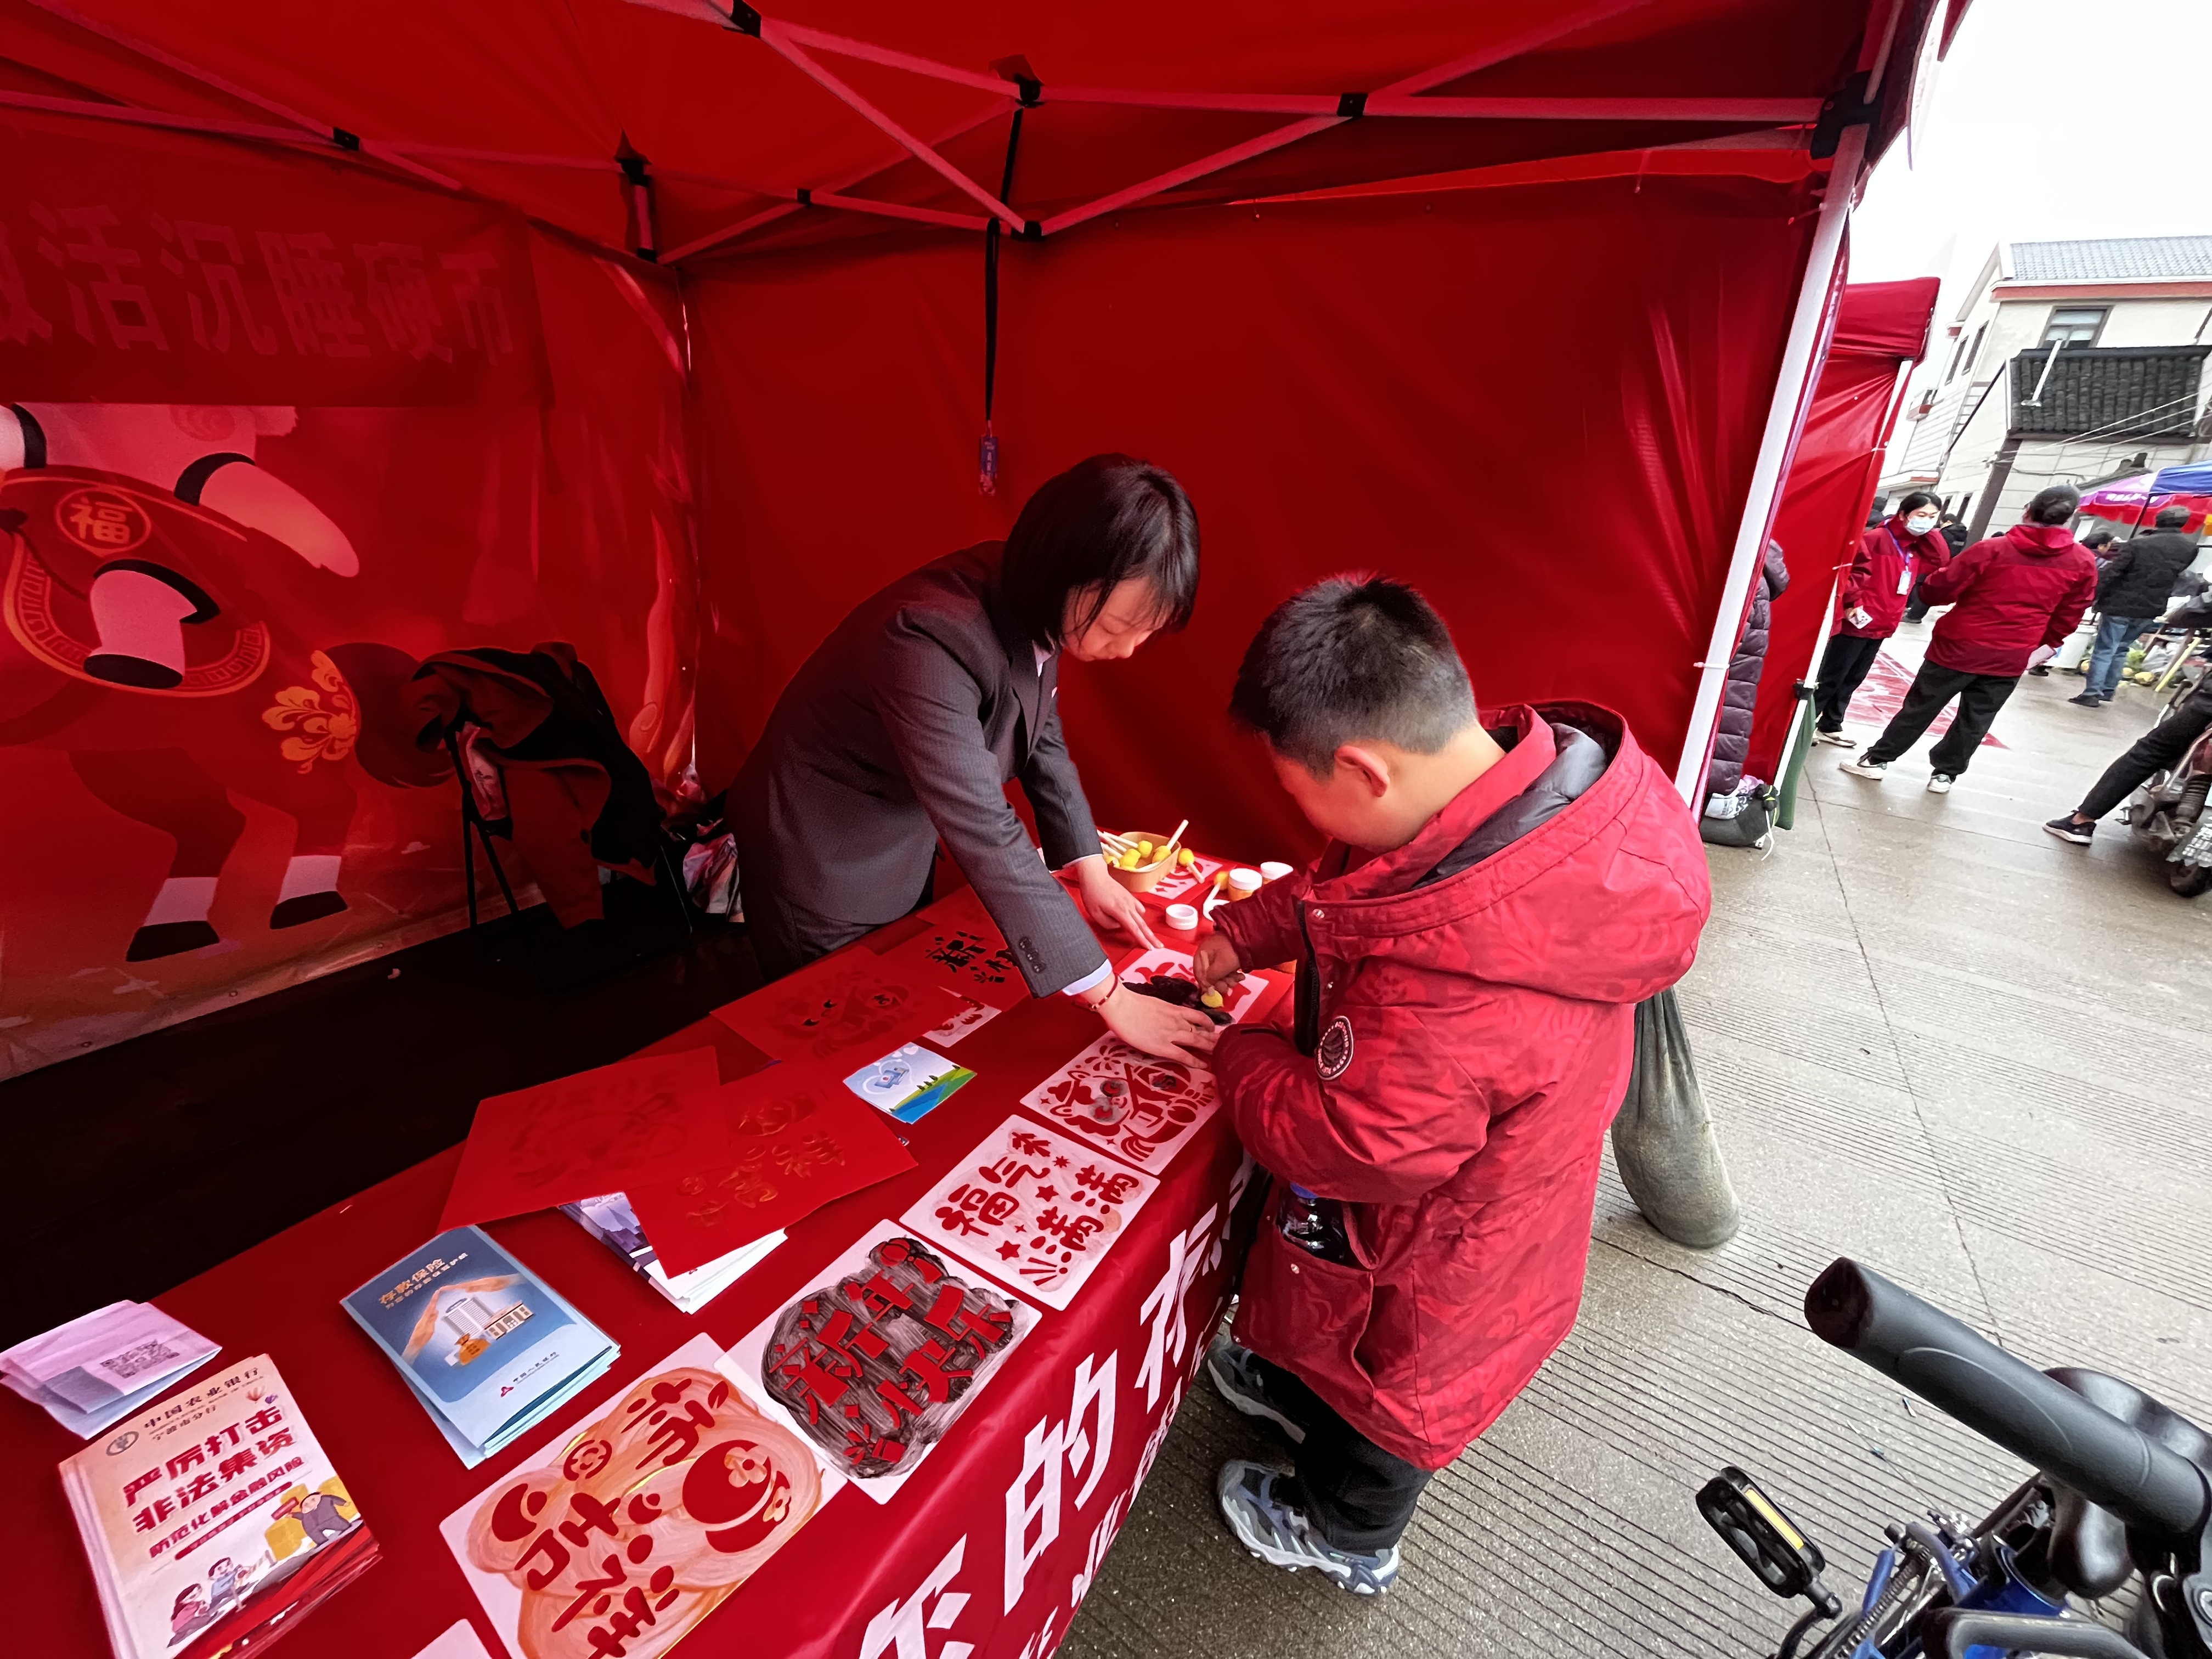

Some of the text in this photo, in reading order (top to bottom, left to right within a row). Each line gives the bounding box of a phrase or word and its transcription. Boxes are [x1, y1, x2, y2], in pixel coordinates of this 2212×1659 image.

[70, 495, 136, 545] 福
[935, 1155, 1051, 1237] 福气
[144, 1367, 259, 1429] 中国农业银行
[770, 1269, 914, 1425] 新年
[877, 1284, 1014, 1429] 快乐
[122, 1405, 284, 1508] 严厉打击
[132, 1427, 296, 1534] 非法集资
